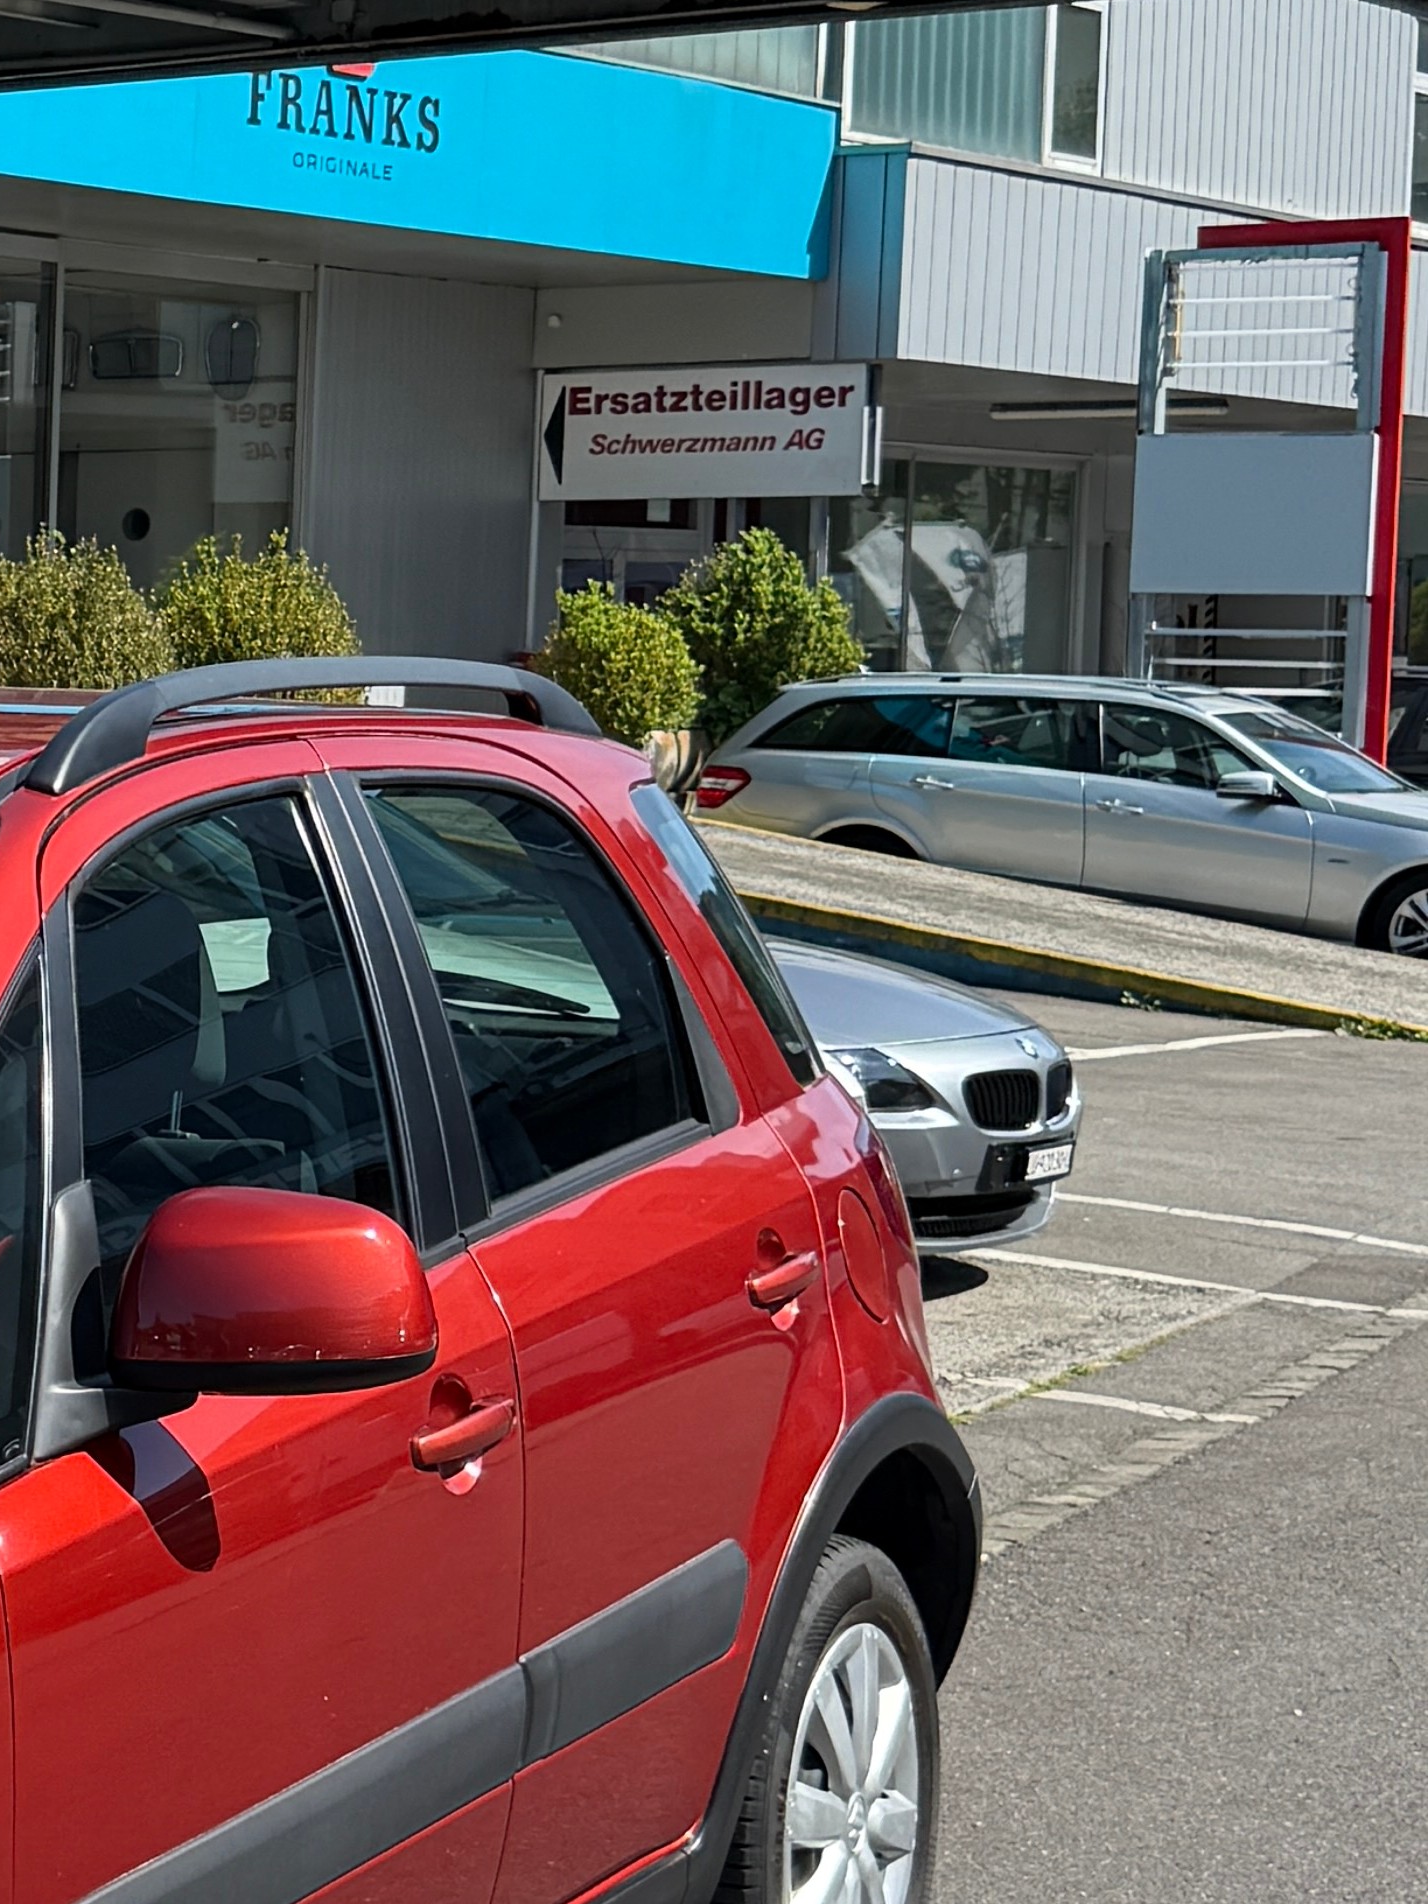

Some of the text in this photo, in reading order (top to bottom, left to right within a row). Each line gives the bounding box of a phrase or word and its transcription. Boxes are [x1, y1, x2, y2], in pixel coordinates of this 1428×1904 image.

[246, 71, 440, 153] FRANKS
[293, 152, 393, 180] ORIGINALE
[568, 380, 855, 416] Ersatzteillager
[588, 427, 826, 455] Schwerzmann AG
